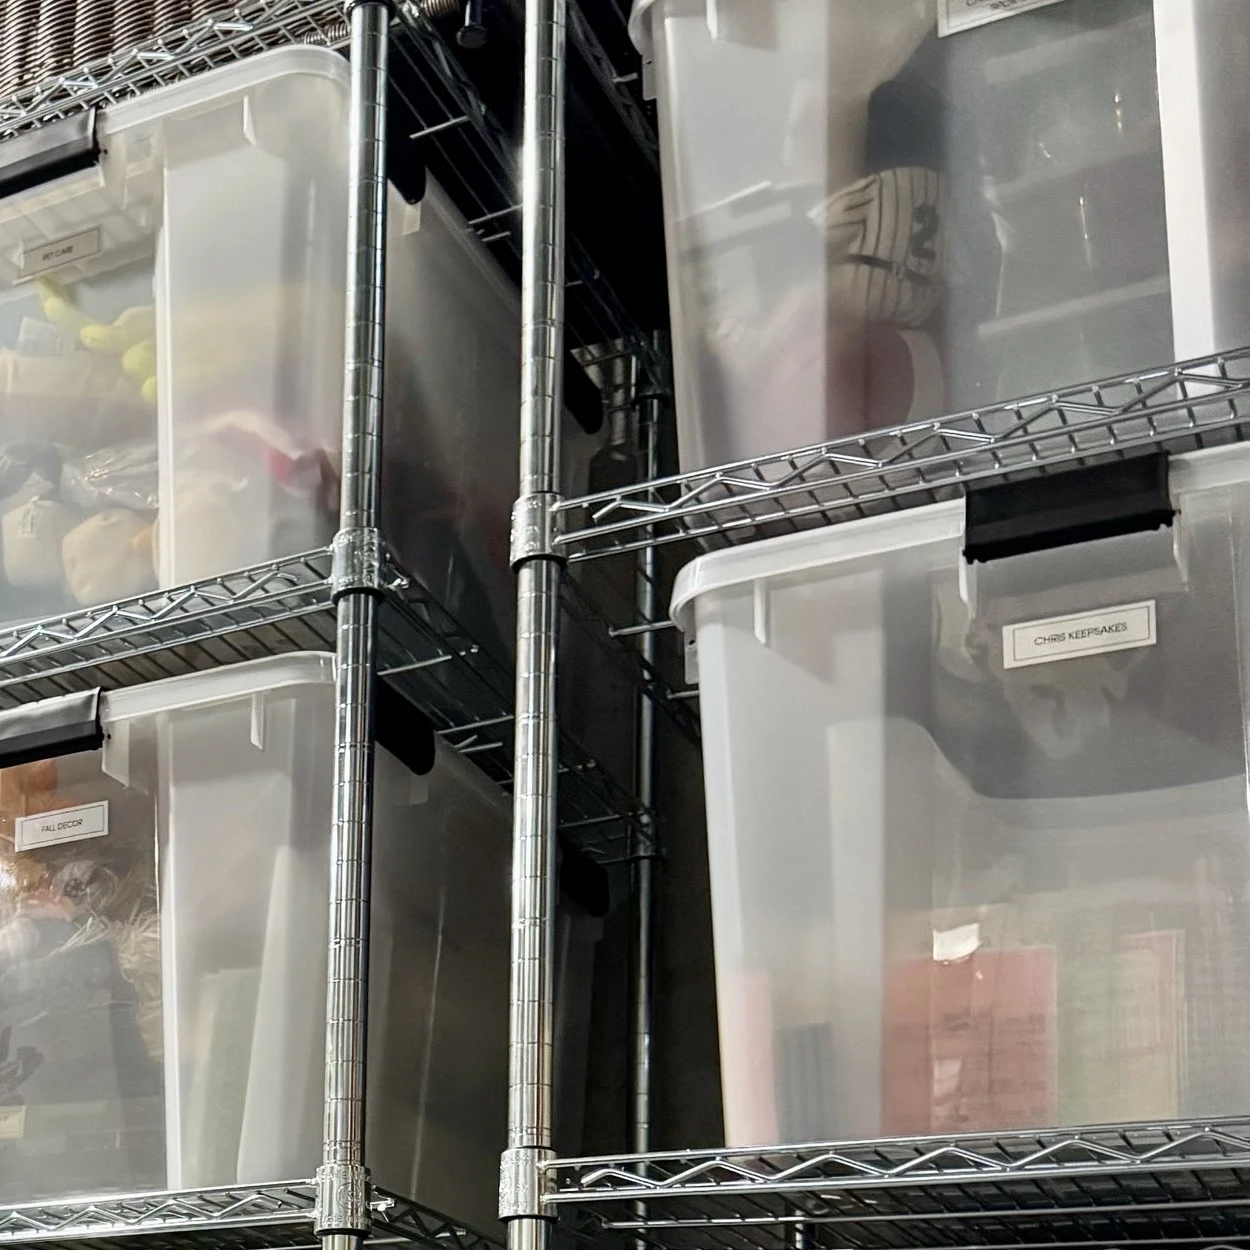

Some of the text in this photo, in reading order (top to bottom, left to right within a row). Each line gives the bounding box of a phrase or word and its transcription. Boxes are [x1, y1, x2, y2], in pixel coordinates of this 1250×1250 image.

[1034, 622, 1128, 647] CHRIS KEEPSAKES
[41, 819, 83, 833] FALL DECOR
